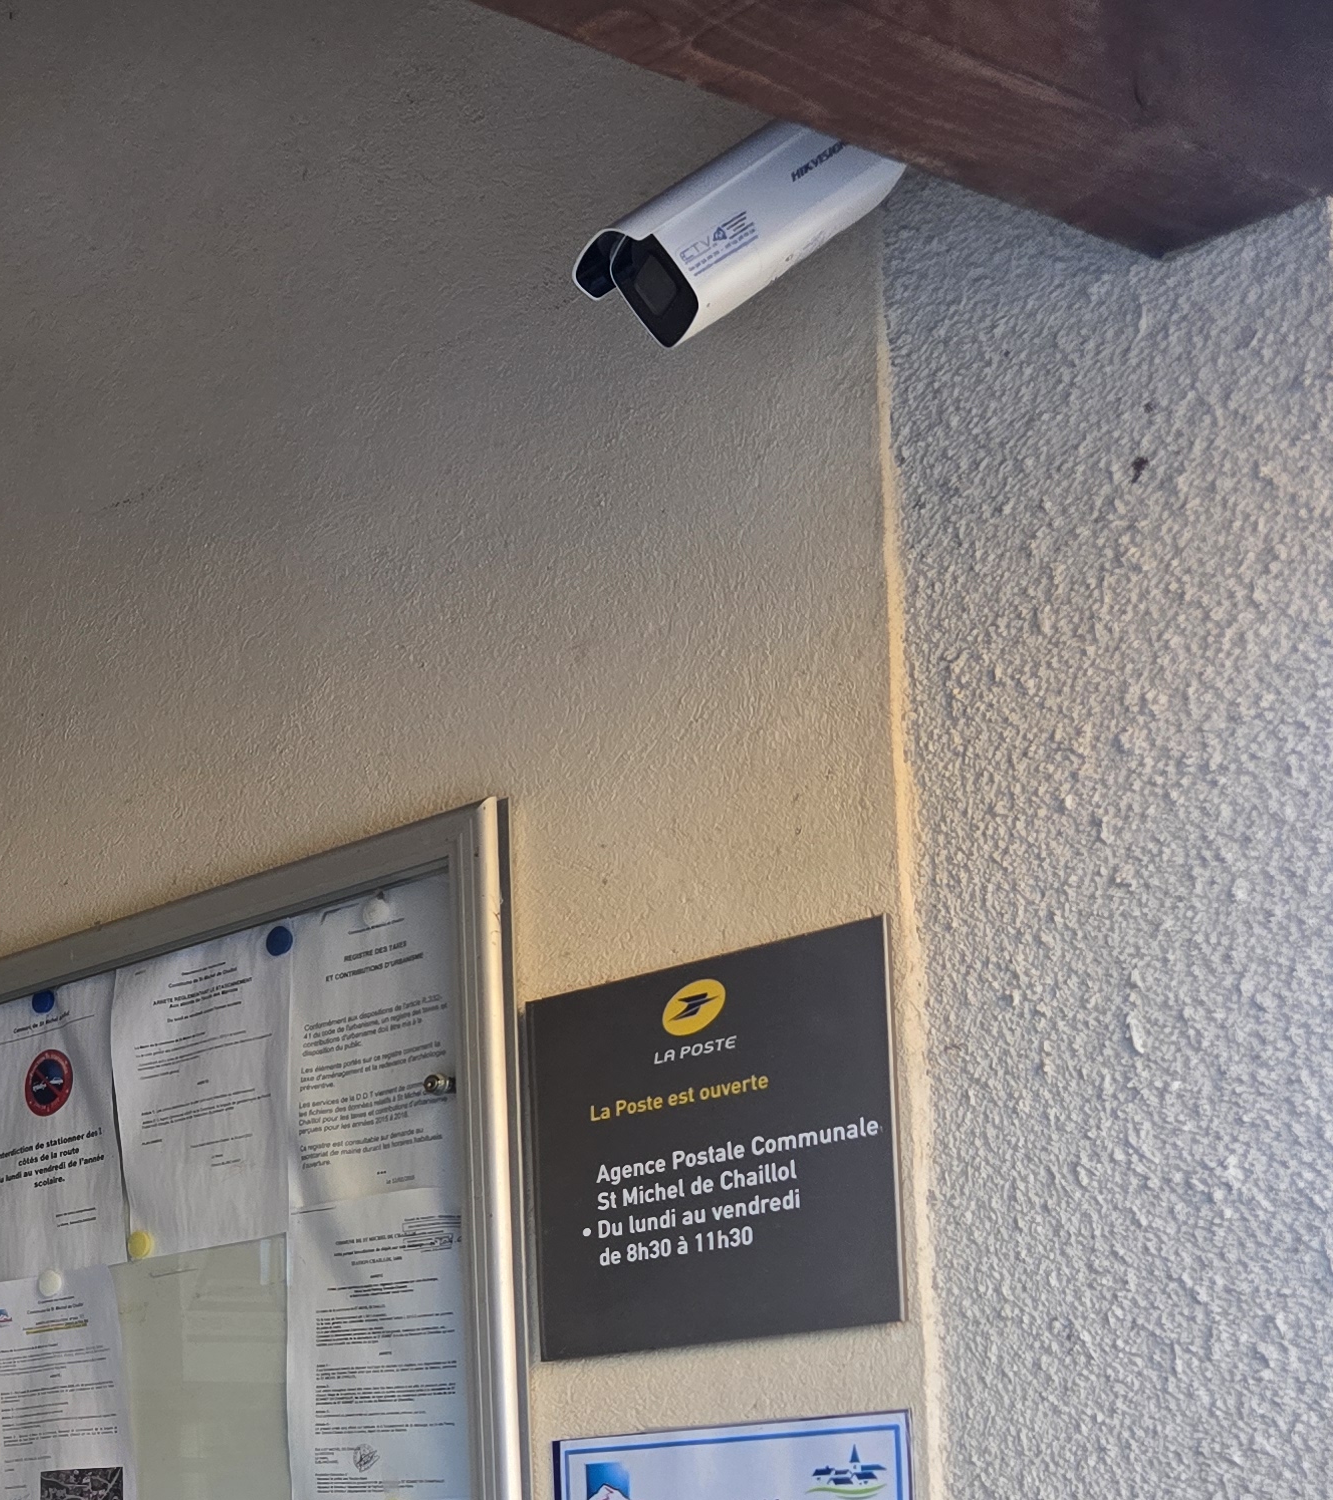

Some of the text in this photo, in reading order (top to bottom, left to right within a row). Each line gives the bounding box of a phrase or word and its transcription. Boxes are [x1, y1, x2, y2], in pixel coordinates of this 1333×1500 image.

[654, 1036, 737, 1064] LA POSTE
[590, 1075, 769, 1121] La Poste est ouverte
[46, 1133, 84, 1147] stationner
[60, 1147, 79, 1157] route
[596, 1118, 879, 1185] Agence Postale Communale
[6, 1172, 21, 1181] lundi
[35, 1162, 66, 1175] vendredi
[34, 1176, 65, 1188] scolaire.
[597, 1160, 797, 1210] St Michel de Chaillol
[598, 1189, 800, 1239] Du lundi au vendredi
[599, 1226, 753, 1266] de 8h30 à 11h30
